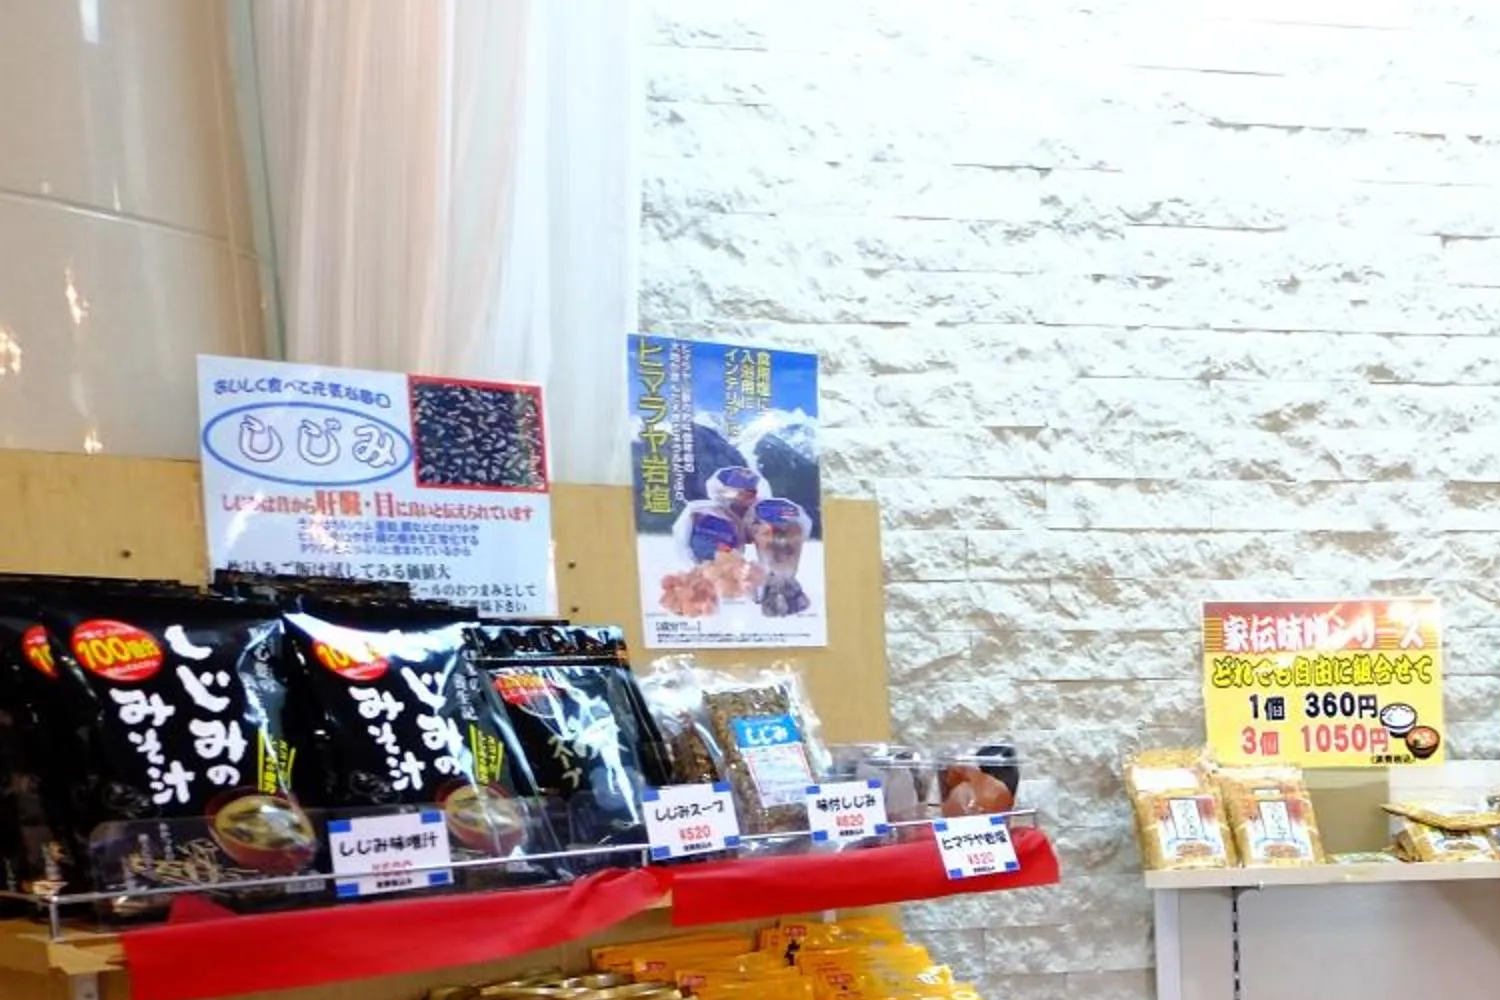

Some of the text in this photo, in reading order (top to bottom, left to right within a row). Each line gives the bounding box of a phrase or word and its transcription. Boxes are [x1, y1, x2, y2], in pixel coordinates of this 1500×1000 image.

[239, 414, 397, 469] しじみ
[222, 489, 535, 521] しじは昔から肝臓・目に良いと伝えられています
[1212, 654, 1434, 688] どれでも自由に組合せて
[1249, 692, 1379, 721] 1個 360円
[1241, 725, 1389, 756] 3個 1050円
[655, 800, 724, 822] しじみスープ
[816, 794, 876, 812] 味付しじみ
